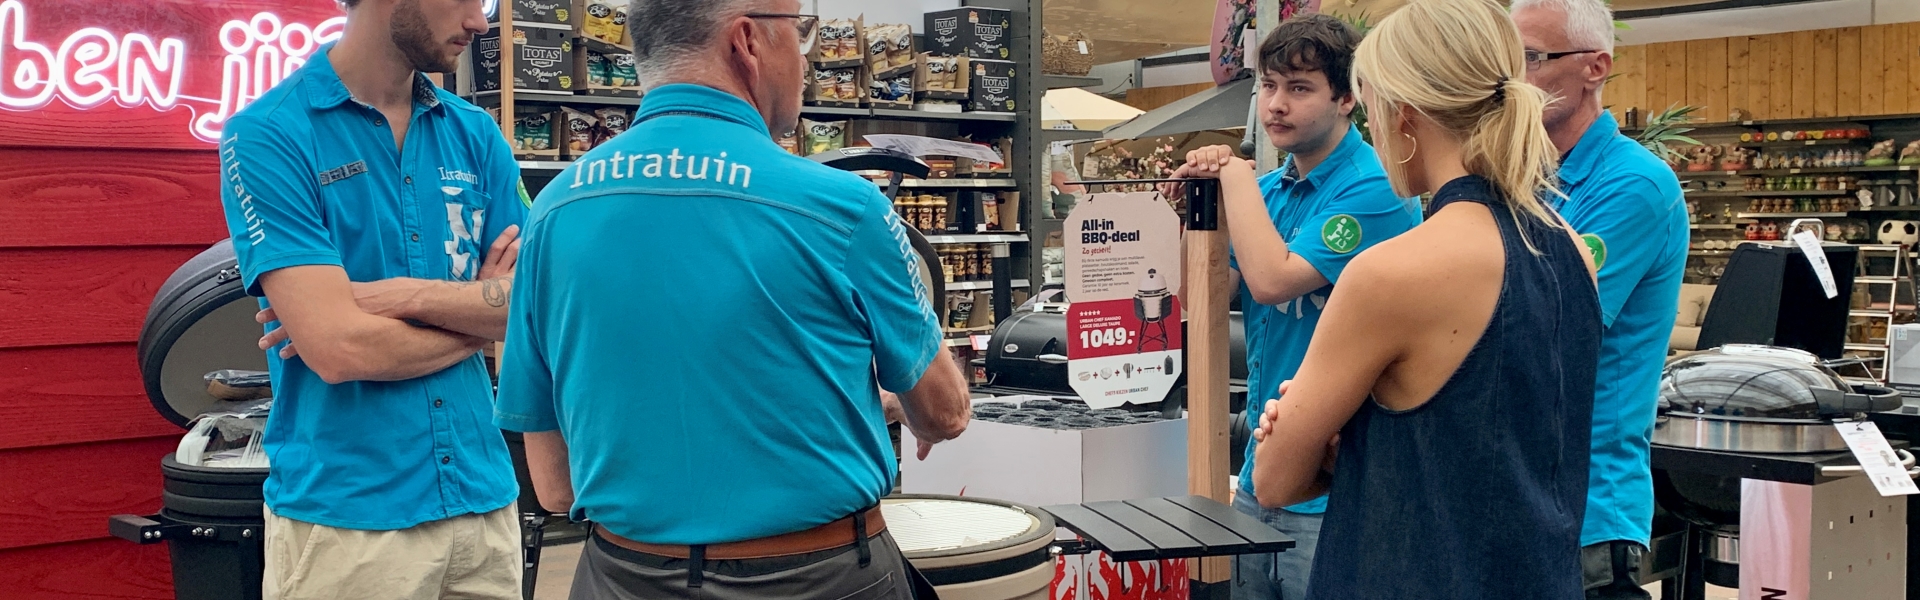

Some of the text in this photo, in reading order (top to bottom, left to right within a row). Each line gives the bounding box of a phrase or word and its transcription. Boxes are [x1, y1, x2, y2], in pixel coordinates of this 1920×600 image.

[977, 26, 1001, 34] TOTAS
[524, 48, 560, 59] TOTAS
[984, 79, 1008, 87] TOTAS
[569, 148, 752, 189] Intratuin
[223, 132, 266, 246] Intratuin
[1081, 219, 1114, 231] All-in
[1082, 230, 1140, 244] BBQ-deal
[884, 204, 928, 321] Intratuin
